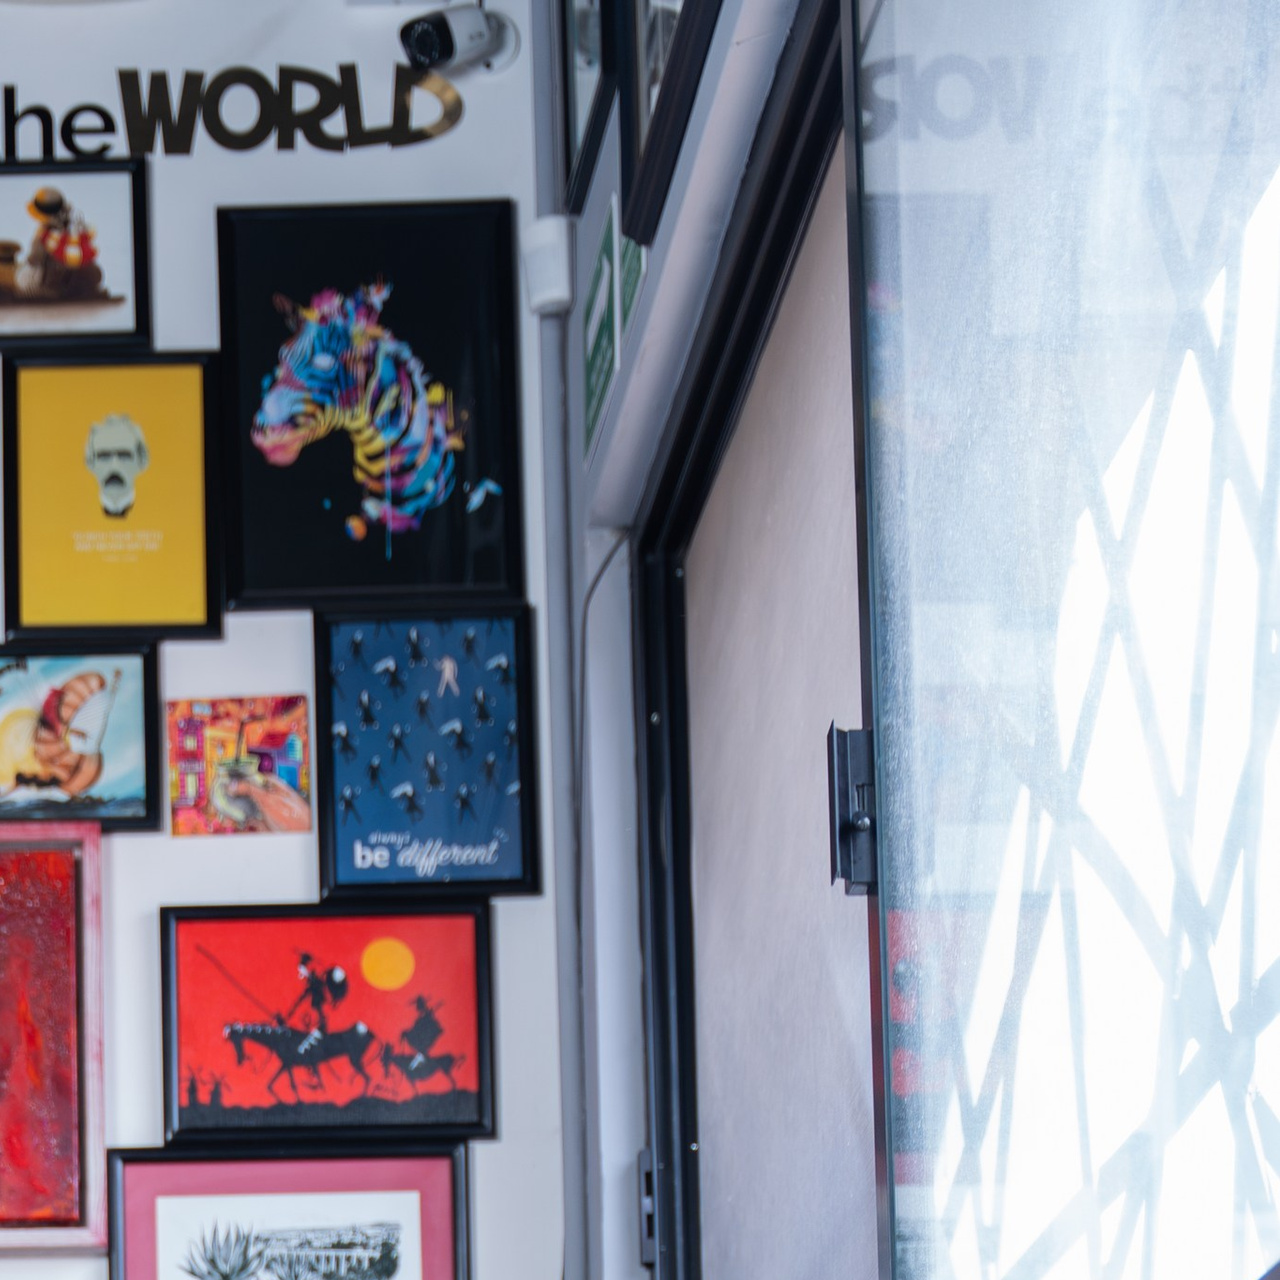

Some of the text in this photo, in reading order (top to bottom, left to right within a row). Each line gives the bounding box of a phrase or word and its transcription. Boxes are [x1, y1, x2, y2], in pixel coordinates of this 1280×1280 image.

[116, 62, 465, 155] WORLD
[353, 836, 499, 878] be different
